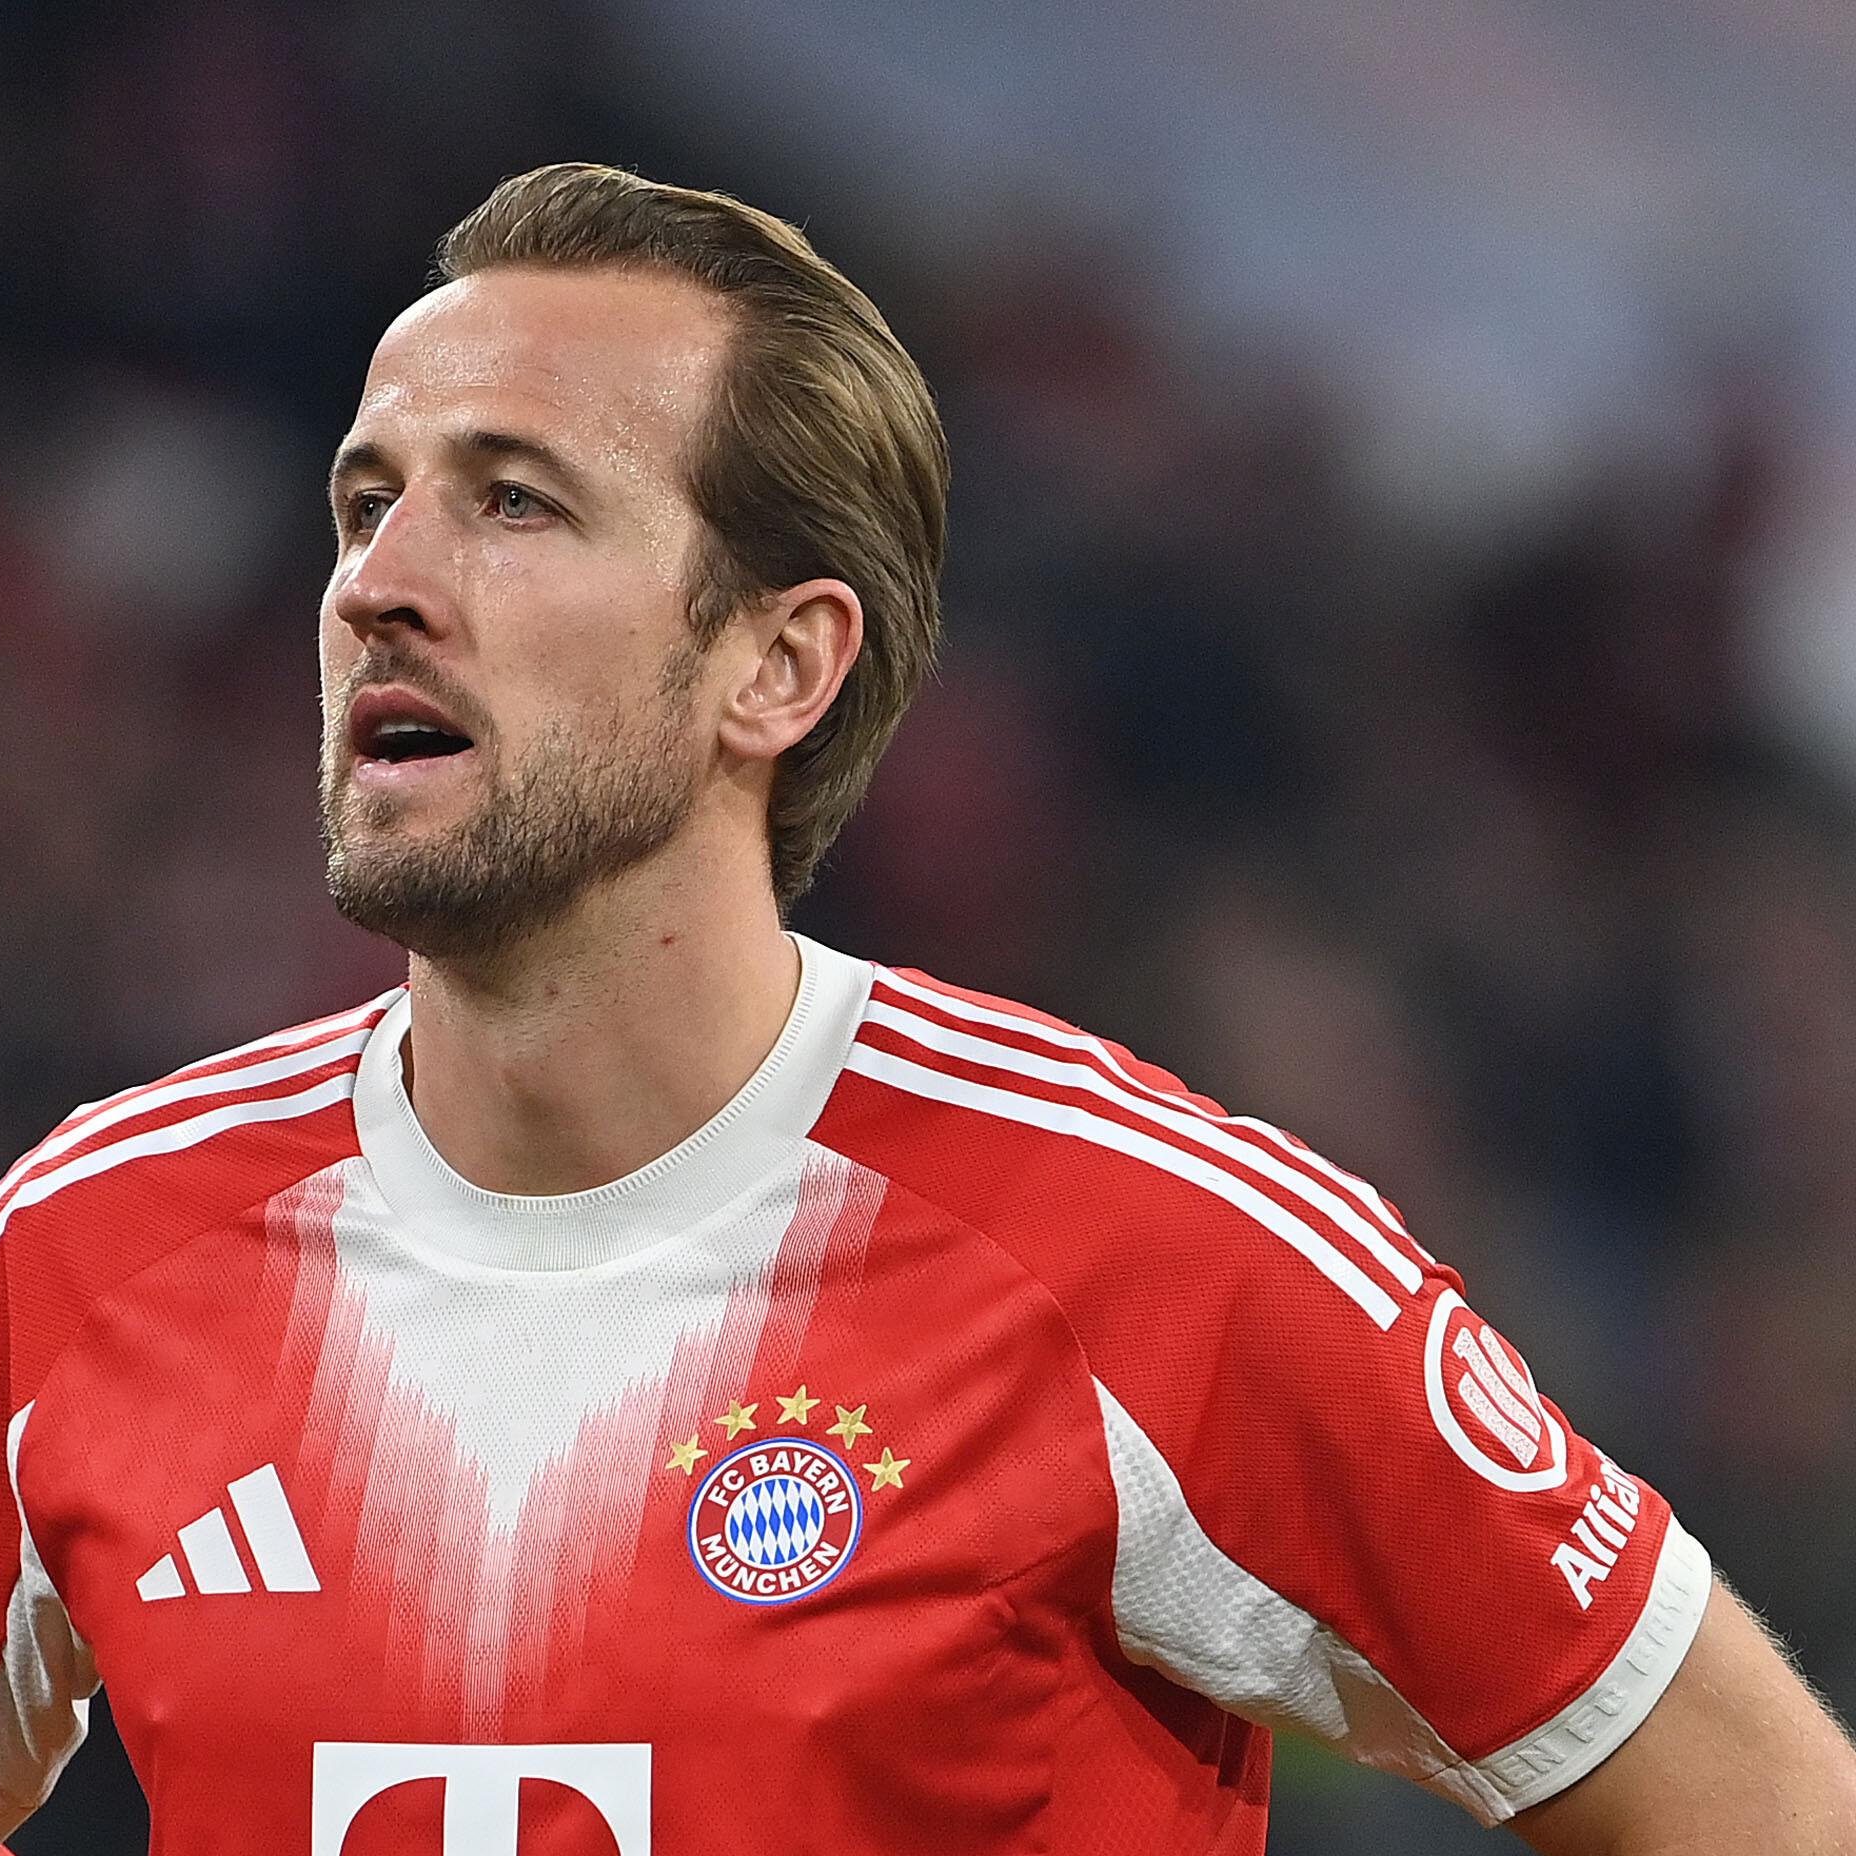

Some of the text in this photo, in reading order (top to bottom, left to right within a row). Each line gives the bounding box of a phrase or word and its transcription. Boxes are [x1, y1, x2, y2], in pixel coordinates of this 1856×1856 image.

[708, 1451, 849, 1515] FC BAYERN
[700, 1533, 841, 1594] MÜNCHEN
